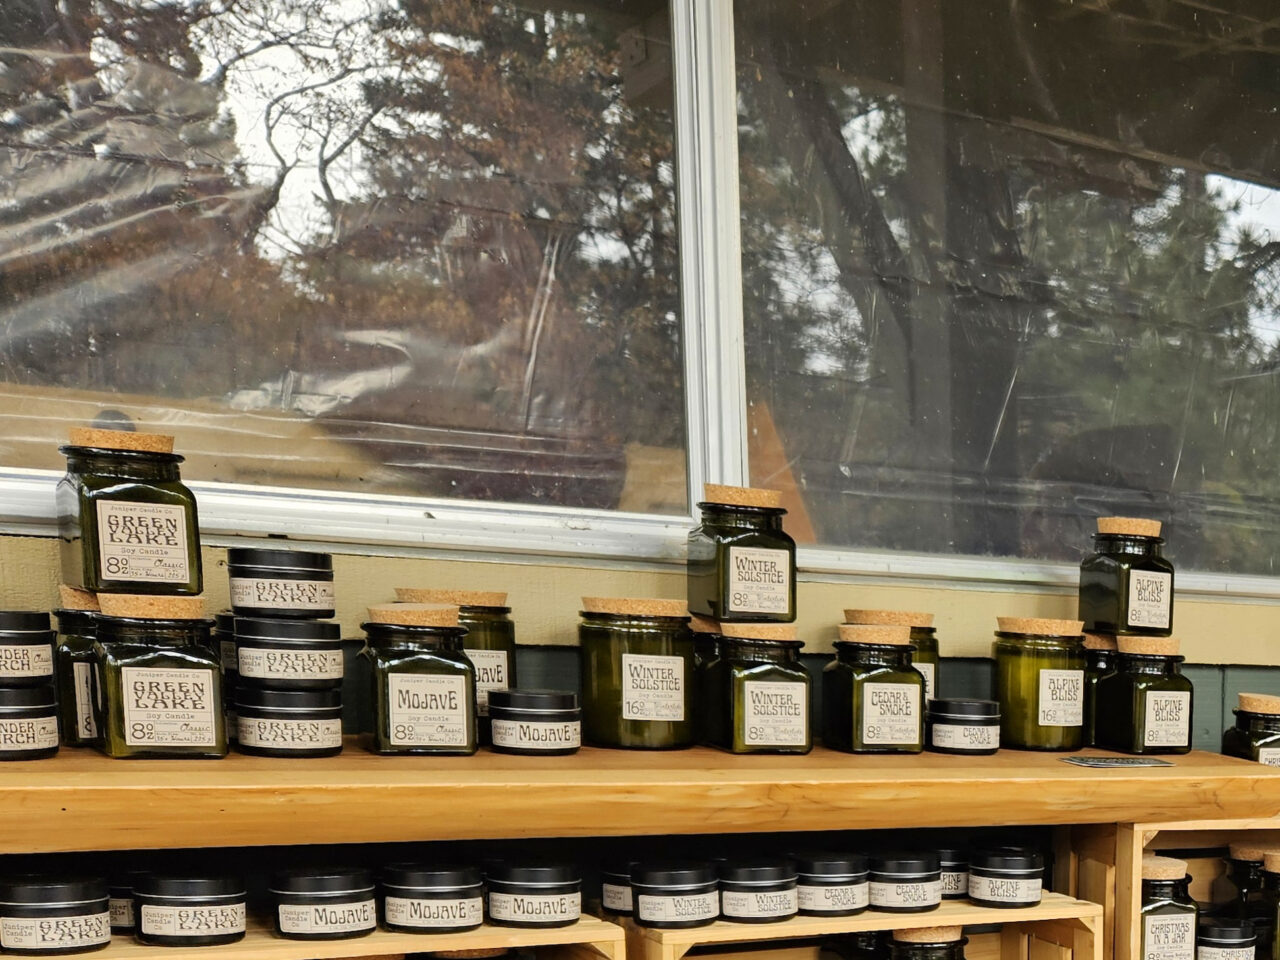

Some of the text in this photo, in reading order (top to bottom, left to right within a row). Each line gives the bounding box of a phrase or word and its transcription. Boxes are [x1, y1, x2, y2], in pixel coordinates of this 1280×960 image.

[108, 515, 177, 528] GREEN
[109, 526, 177, 537] VALLEY
[110, 533, 178, 545] LAKE
[736, 556, 777, 572] WINTER
[738, 571, 784, 583] SOLSTICE
[256, 582, 318, 590] GREEN
[1136, 579, 1164, 592] ALPINE
[257, 589, 318, 597] VALLEY
[257, 595, 318, 603] LAKE
[1137, 590, 1162, 603] BLISS
[267, 653, 328, 661] GREEN
[268, 659, 328, 668] VALLEY
[268, 665, 328, 673] LAKE
[629, 664, 674, 679] WINTER
[133, 681, 204, 692] GREEN
[632, 678, 680, 691] SOLSTICE
[1049, 678, 1079, 690] ALPINE
[134, 691, 204, 700] VALLEY
[398, 689, 458, 710] MOJAVE
[751, 691, 793, 705] WINTER
[871, 691, 902, 705] CEDAR
[1051, 690, 1078, 701] BLISS
[136, 699, 205, 709] LAKE
[753, 704, 800, 716] SOLSTICE
[880, 702, 911, 715] SMOKE
[1153, 700, 1183, 711] ALPINE
[1155, 710, 1180, 721] BLISS
[257, 722, 319, 730] GREEN
[258, 728, 319, 737] VALLEY
[259, 734, 319, 742] LAKE
[519, 725, 570, 741] MOJAVE
[896, 885, 920, 896] CEDAR
[988, 880, 1021, 890] ALPINE
[755, 893, 790, 904] WINTER
[824, 888, 848, 900] CEDAR
[903, 891, 928, 903] SMOKE
[990, 887, 1018, 898] BLISS
[672, 897, 710, 908] WINTER
[831, 893, 857, 906] SMOKE
[409, 901, 467, 919] MOJAVE
[513, 897, 567, 915] MOJAVE
[675, 905, 712, 917] SOLSTICE
[757, 902, 792, 913] SOLSTICE
[177, 907, 238, 918] GREEN
[314, 904, 369, 926] MOJAVE
[39, 918, 103, 930] GREEN
[179, 920, 238, 930] LAKE
[1151, 923, 1190, 935] CHRISTMAS
[41, 930, 104, 942] LAKE
[1154, 932, 1186, 944] IN A JAR
